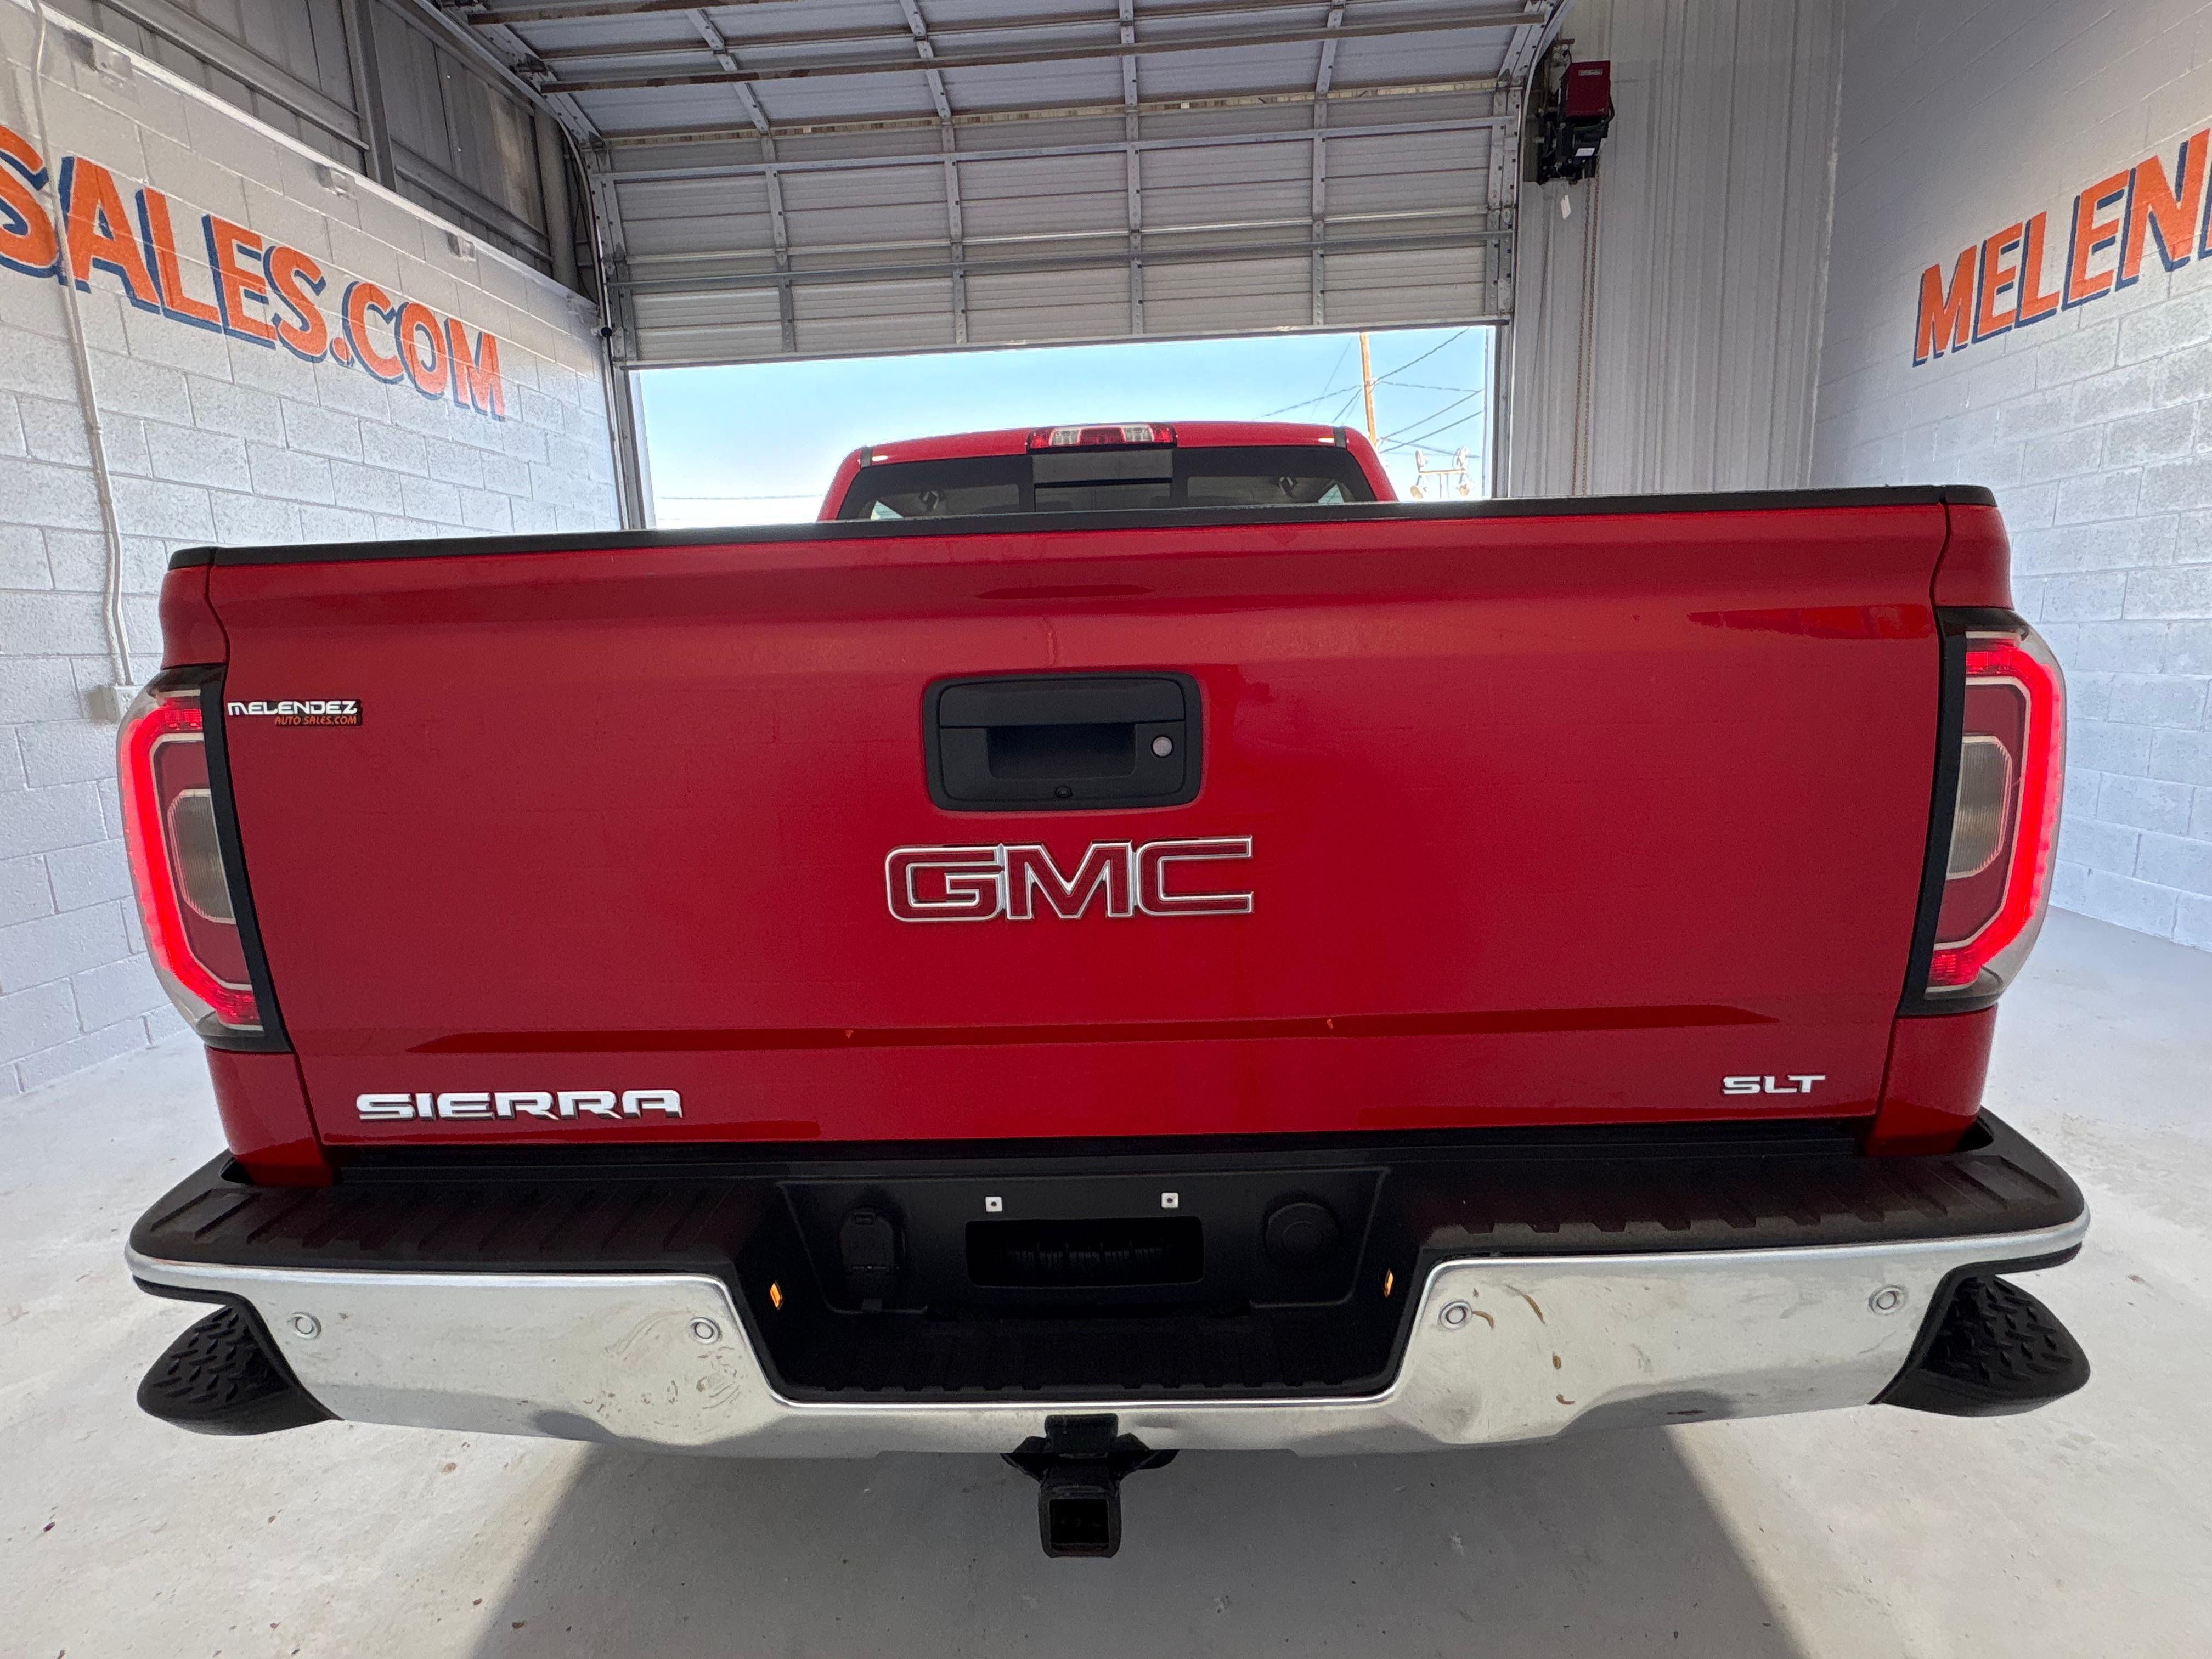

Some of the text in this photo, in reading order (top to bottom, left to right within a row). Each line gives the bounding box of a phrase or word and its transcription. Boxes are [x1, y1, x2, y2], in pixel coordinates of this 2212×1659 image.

[1912, 128, 2212, 367] MELEN
[227, 701, 358, 715] MELENDEZ
[274, 715, 357, 725] AUTO SALES.COM
[885, 836, 1254, 922] GMC
[1722, 1075, 1826, 1095] SLT
[356, 1090, 683, 1120] SIERRA
